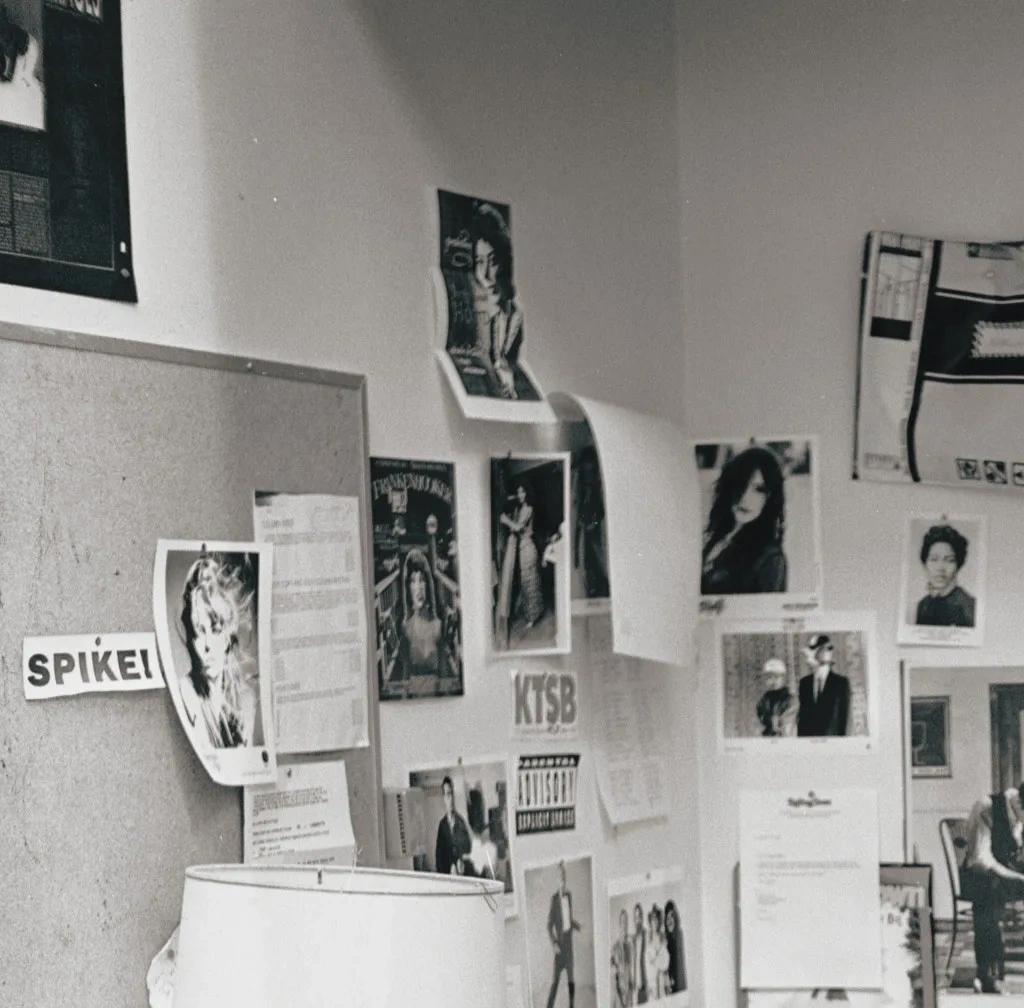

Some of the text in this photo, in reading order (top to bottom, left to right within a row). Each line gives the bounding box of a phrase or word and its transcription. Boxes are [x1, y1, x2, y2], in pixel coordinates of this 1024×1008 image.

[27, 648, 153, 687] SPIKE!
[514, 673, 577, 725] KTSB
[517, 770, 575, 807] ADVISORY
